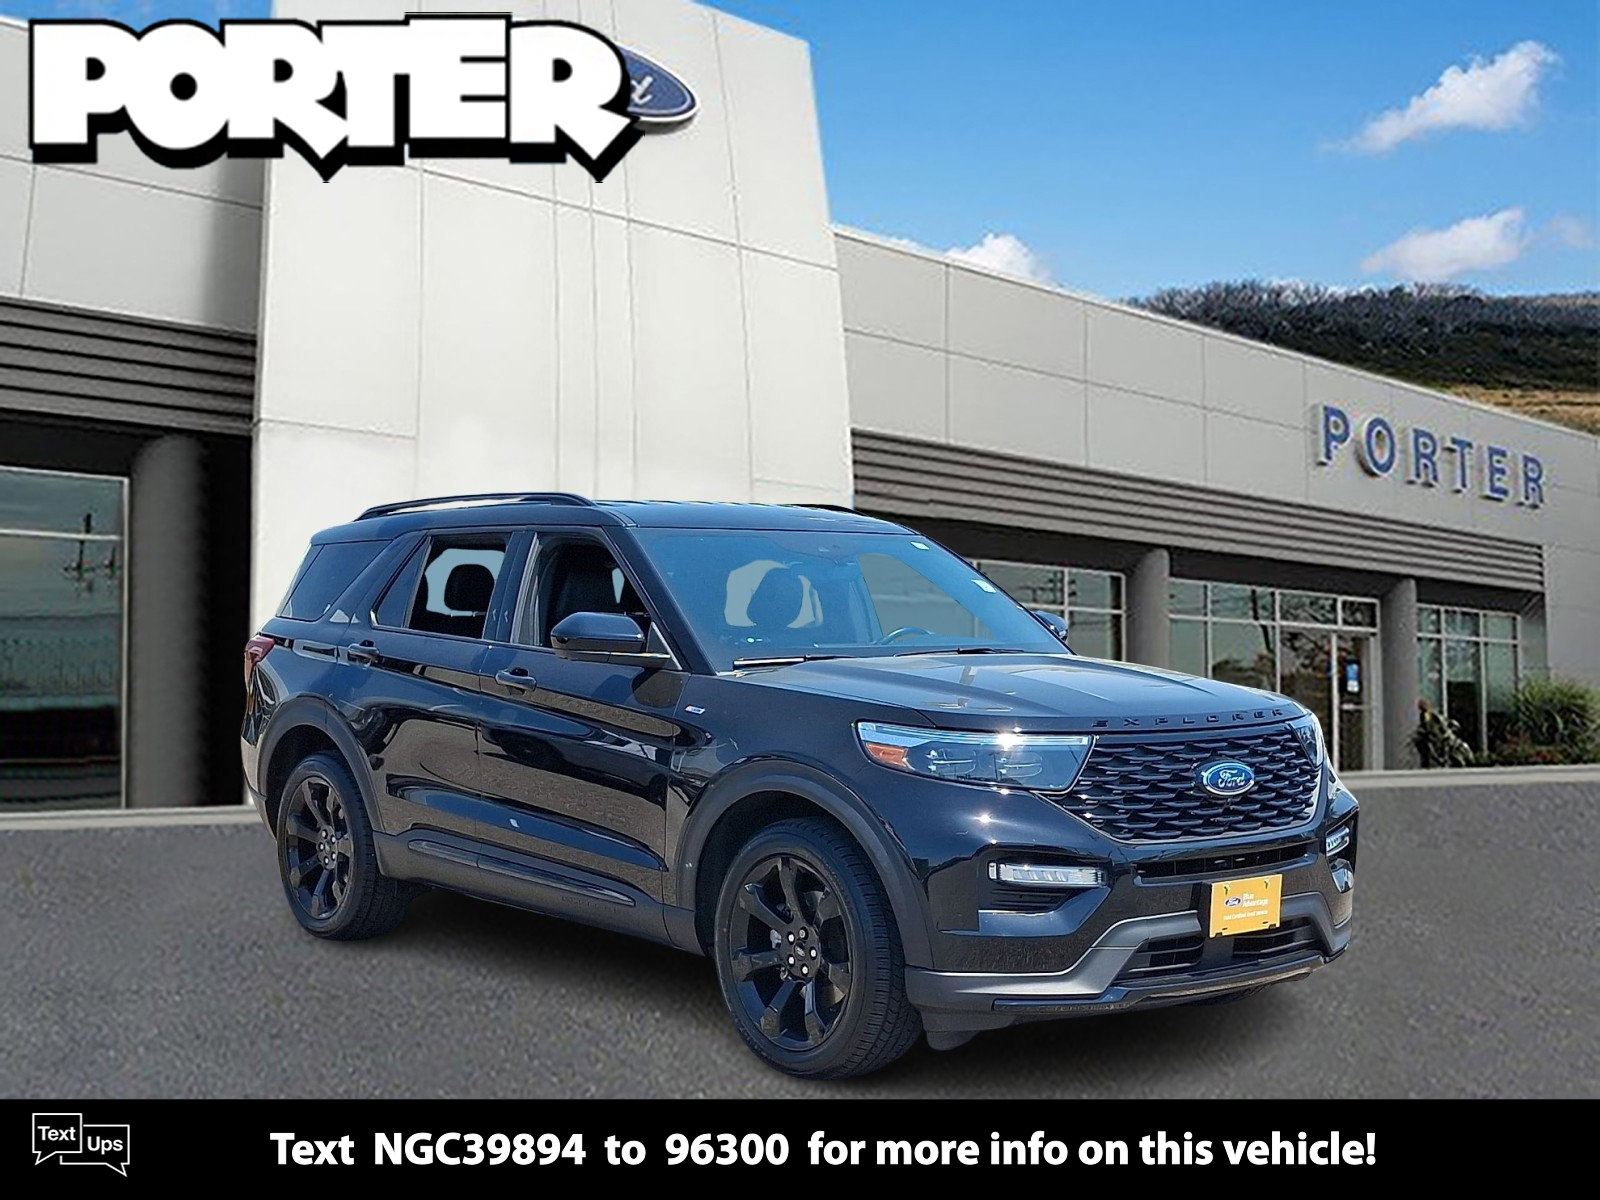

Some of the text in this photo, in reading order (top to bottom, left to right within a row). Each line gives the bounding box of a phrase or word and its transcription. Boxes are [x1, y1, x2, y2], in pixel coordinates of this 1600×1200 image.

[1320, 404, 1545, 506] PORTER
[1092, 708, 1283, 728] EXPLORER
[1217, 769, 1246, 788] Ford
